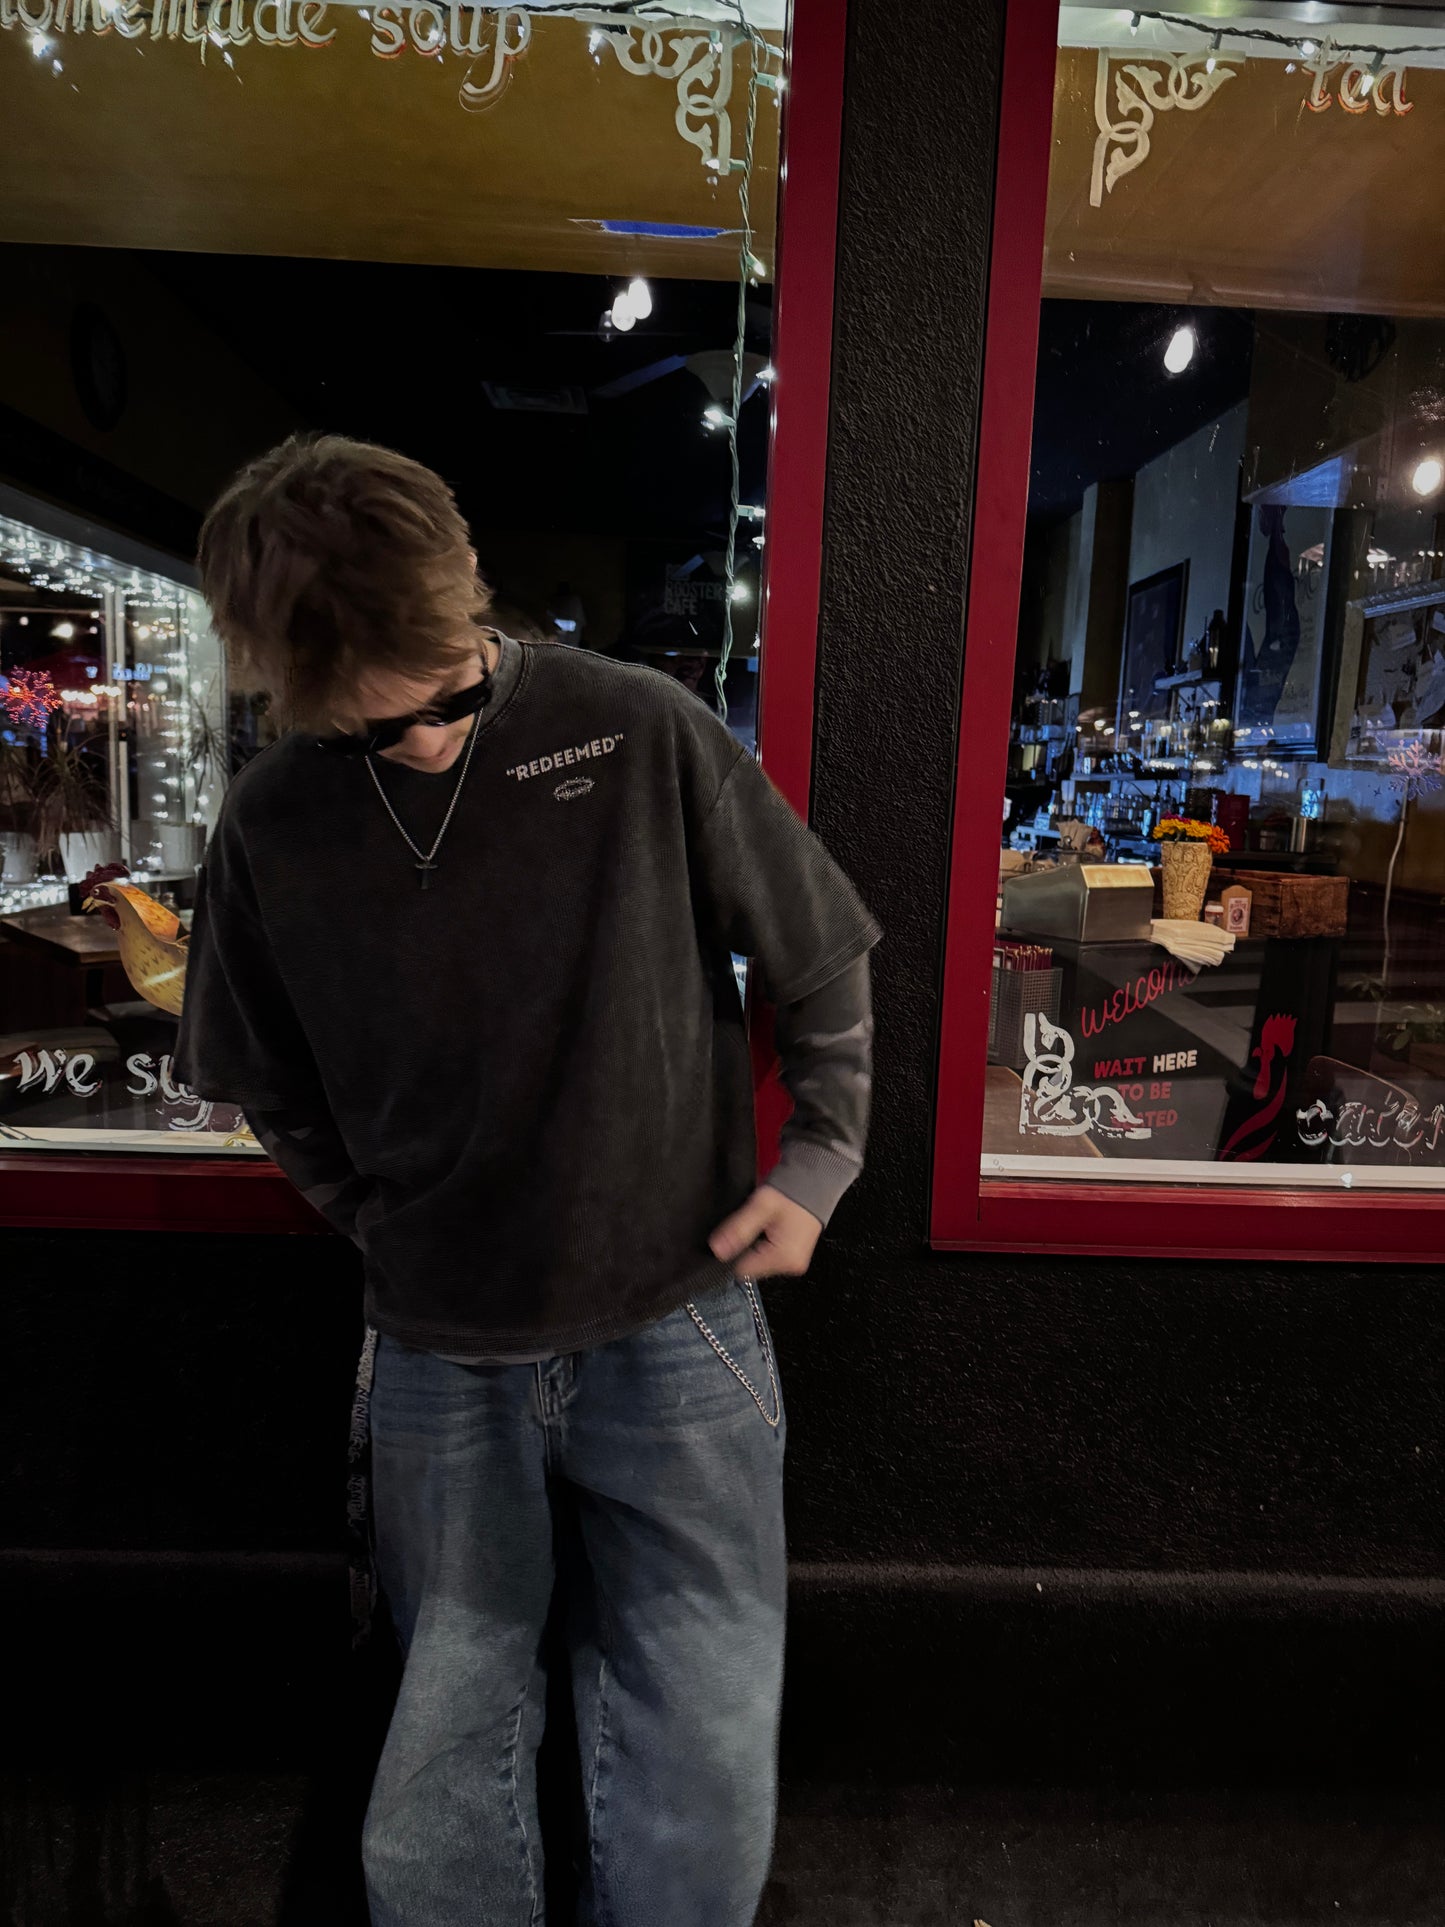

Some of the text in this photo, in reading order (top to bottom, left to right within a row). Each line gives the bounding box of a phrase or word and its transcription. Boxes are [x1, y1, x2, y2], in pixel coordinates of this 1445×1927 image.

[371, 5, 531, 102] soup
[1301, 35, 1414, 116] tea
[1094, 1049, 1198, 1079] WAIT HERE
[1118, 1082, 1172, 1101] TO BE
